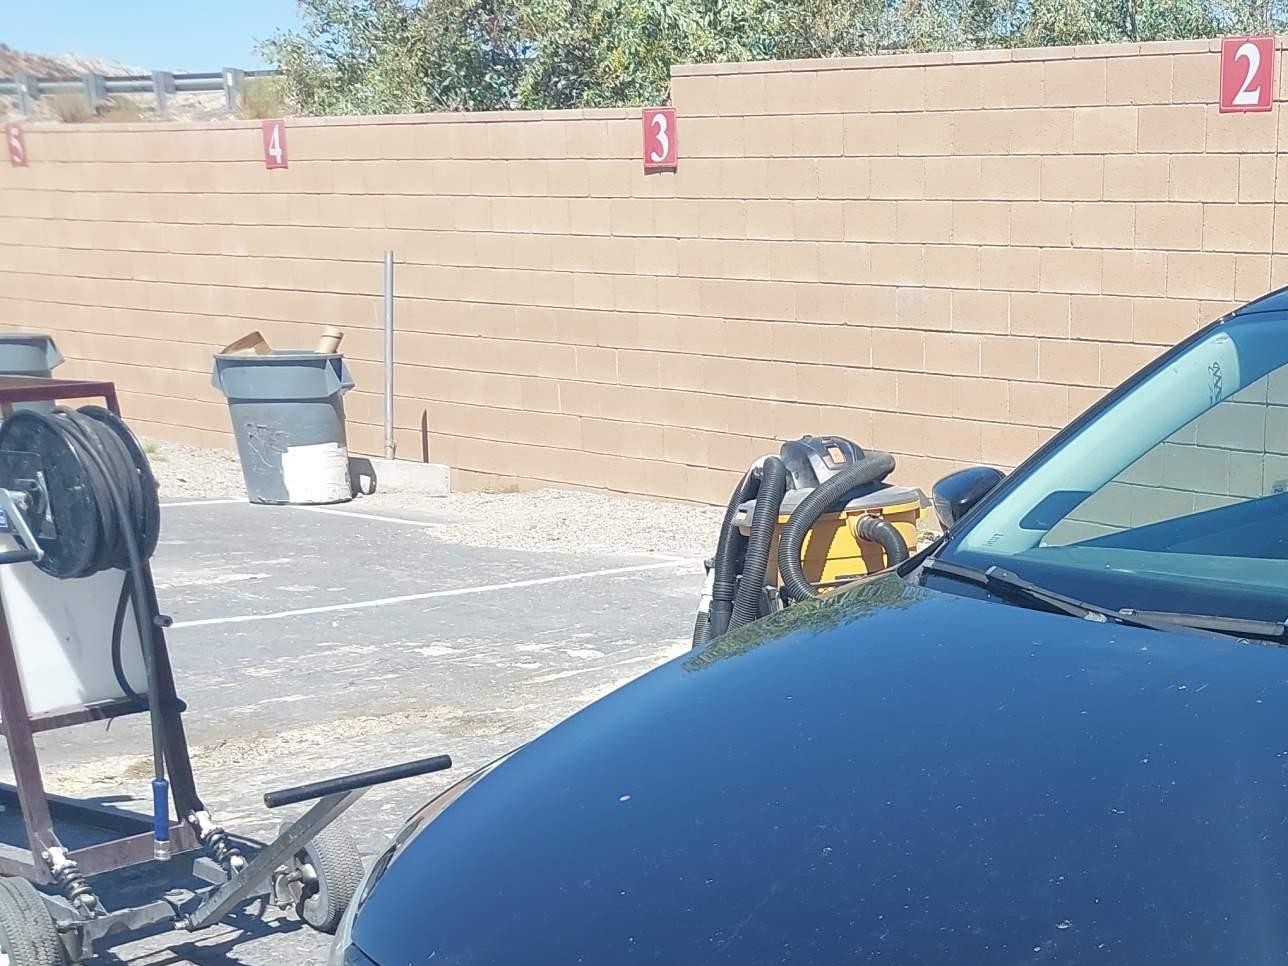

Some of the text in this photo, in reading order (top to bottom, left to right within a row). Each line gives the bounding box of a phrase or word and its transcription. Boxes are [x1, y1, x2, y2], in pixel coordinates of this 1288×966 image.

[1231, 42, 1261, 105] 2
[269, 123, 282, 164] 4
[650, 113, 669, 162] 3
